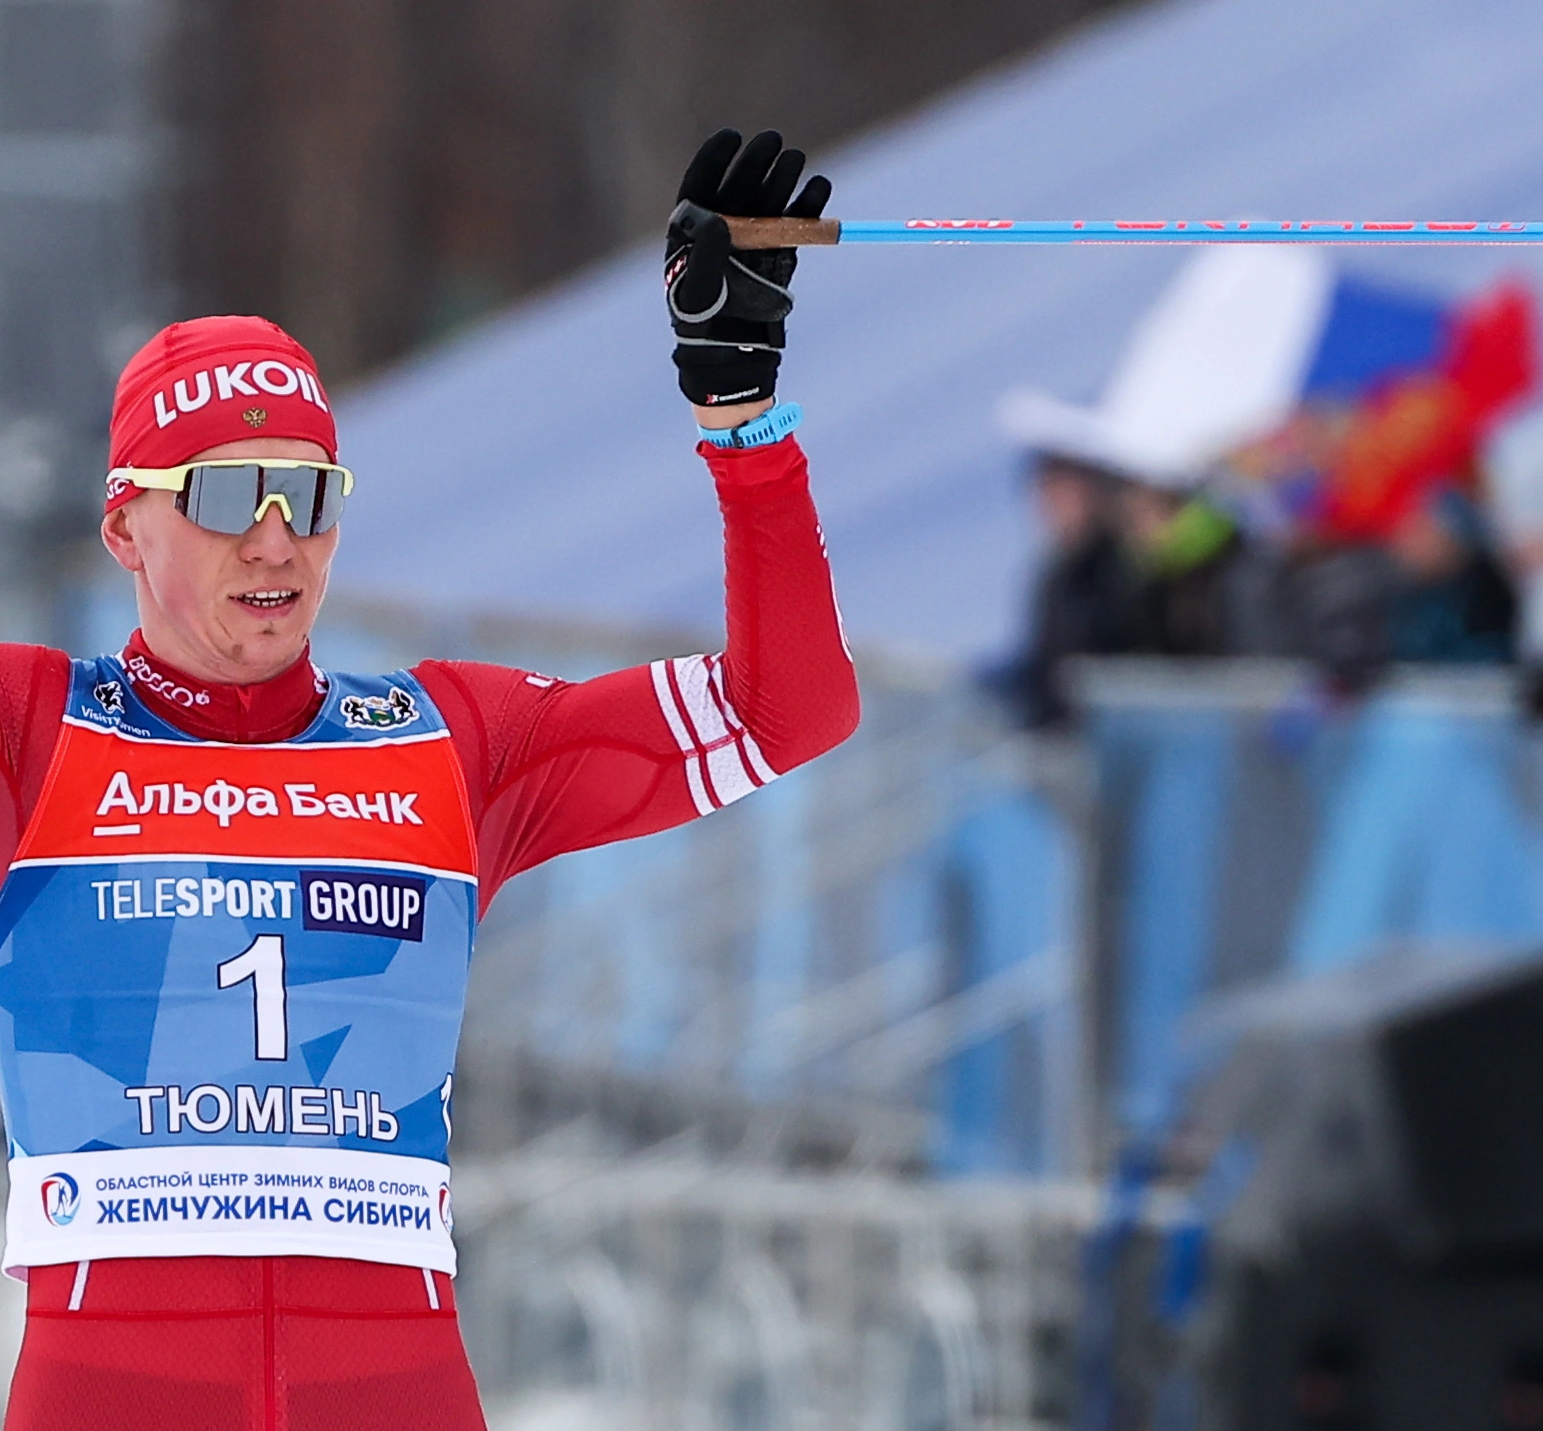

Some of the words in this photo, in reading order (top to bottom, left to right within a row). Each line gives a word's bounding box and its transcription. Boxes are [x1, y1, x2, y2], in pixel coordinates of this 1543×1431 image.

[153, 360, 328, 429] LUKOIL
[95, 770, 279, 829] Альфа
[283, 783, 424, 826] Банк
[91, 877, 296, 920] TELESPORT
[309, 880, 420, 930] GROUP
[216, 932, 287, 1061] 1
[125, 1084, 400, 1142] ТЮМЕНЬ
[96, 1171, 192, 1191] ОБЛАСТНОЙ
[198, 1173, 248, 1188] ЦЕНТР
[254, 1173, 324, 1189] ЗИМНИХ
[329, 1178, 375, 1194] ВИДОВ
[379, 1181, 429, 1198] СПОРТА
[96, 1195, 313, 1224] ЖЕМЧУЖИНА
[323, 1198, 432, 1231] СИБИРИ
